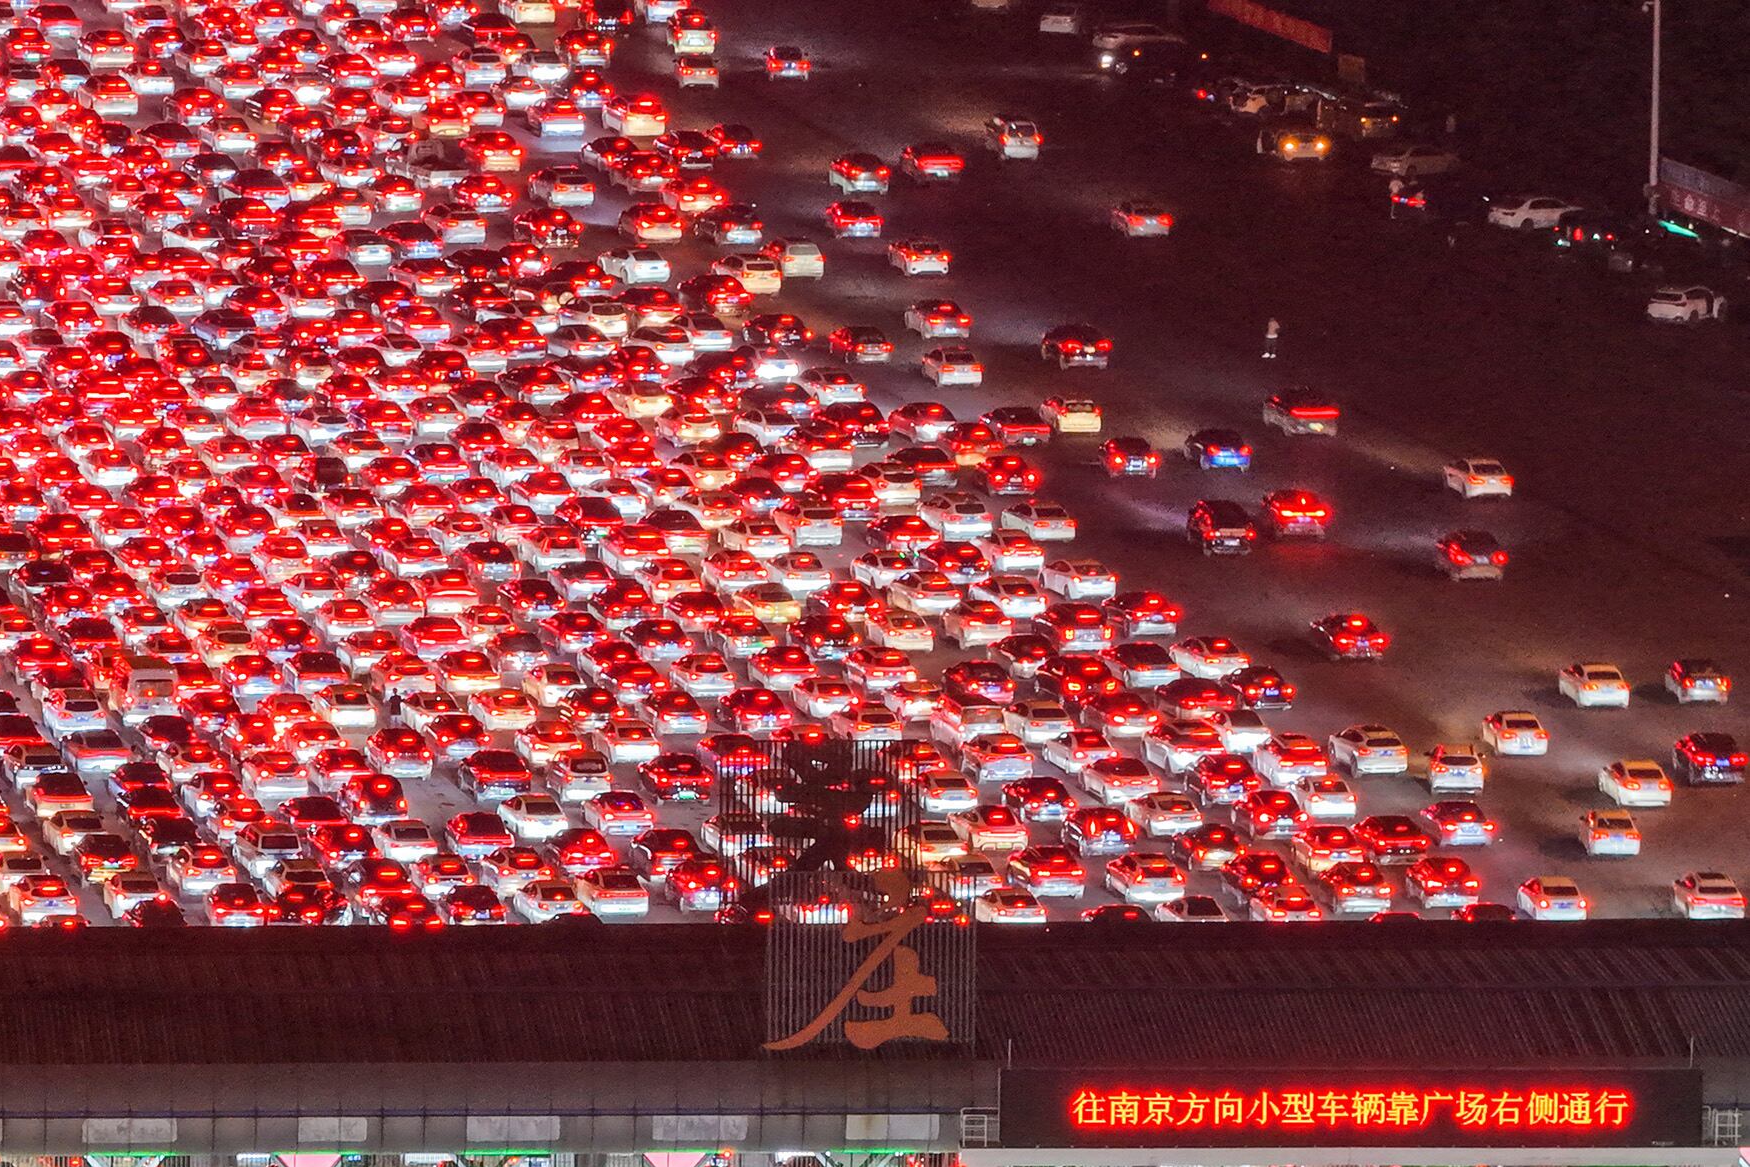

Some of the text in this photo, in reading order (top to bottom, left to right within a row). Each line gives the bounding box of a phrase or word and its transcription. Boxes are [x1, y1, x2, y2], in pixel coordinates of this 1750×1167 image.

[761, 871, 950, 1052] 庄
[1071, 1090, 1630, 1126] 往南京方向小型车辆靠广场右侧通行
